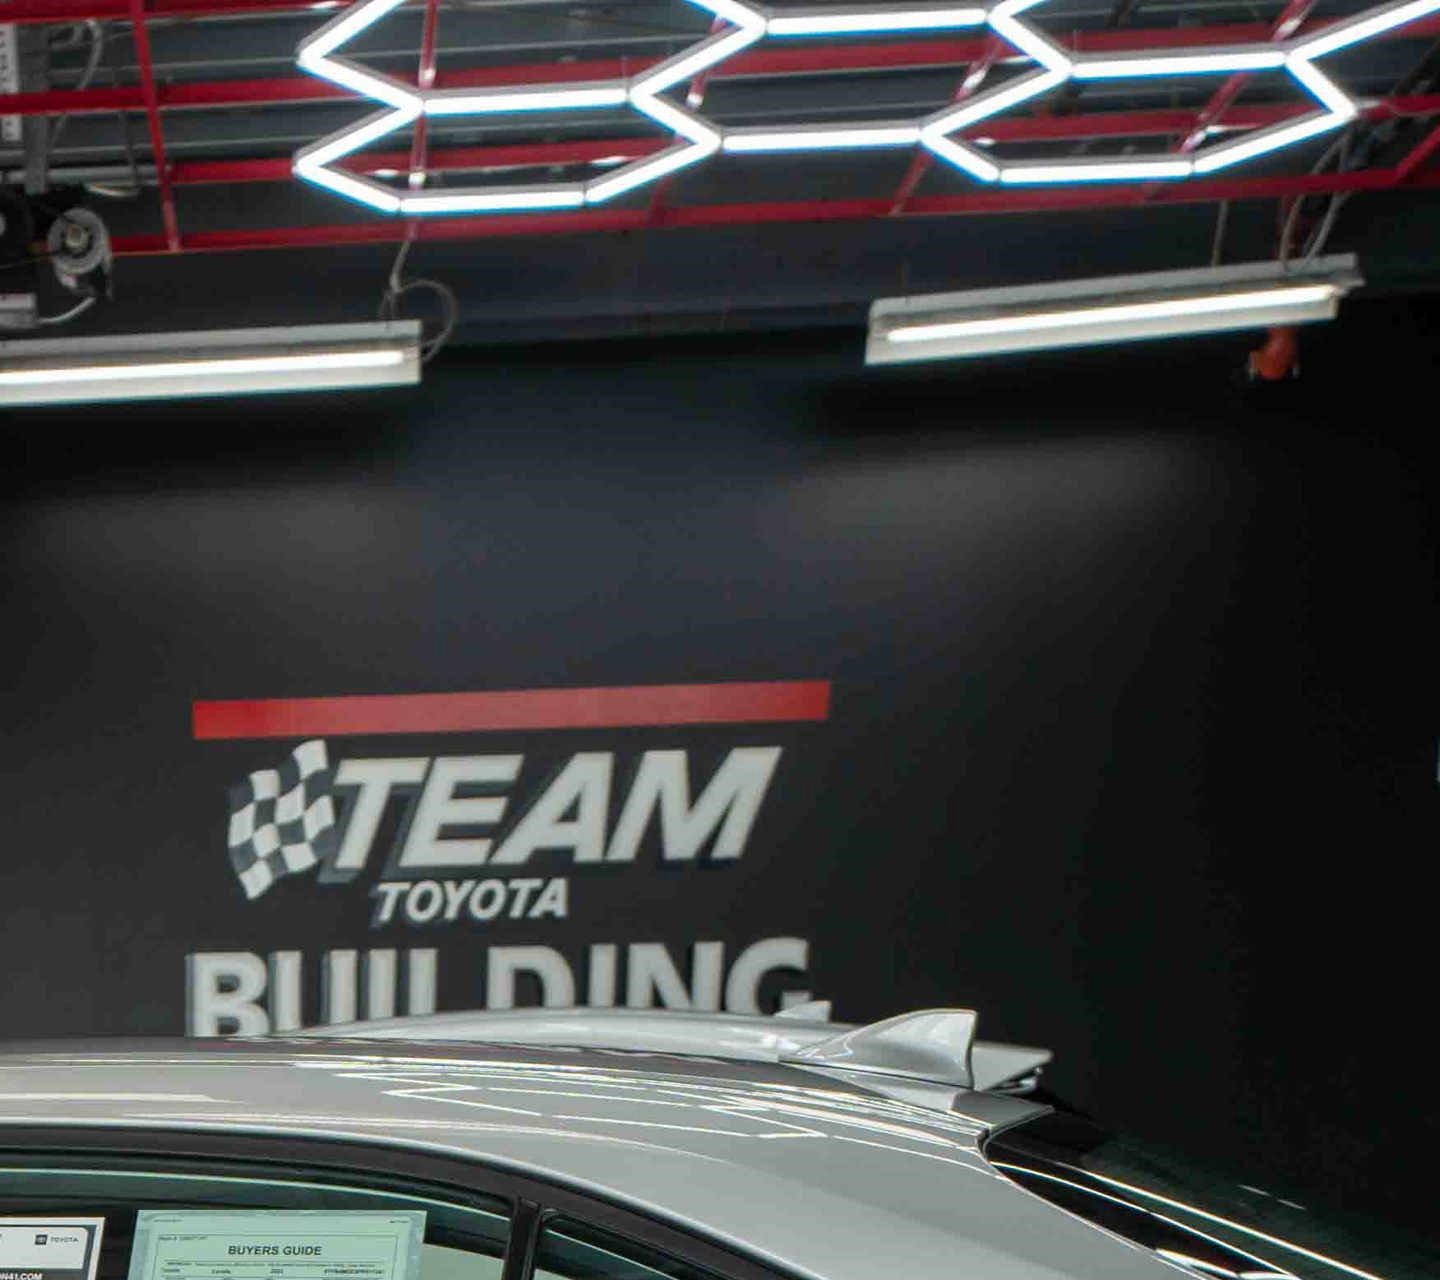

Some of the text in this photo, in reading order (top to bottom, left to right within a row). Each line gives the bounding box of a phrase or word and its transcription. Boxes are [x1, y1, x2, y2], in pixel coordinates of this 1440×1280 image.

[327, 746, 784, 876] TEAM
[374, 878, 569, 924] TOYOTA
[227, 1245, 323, 1256] BUYERS GUIDE
